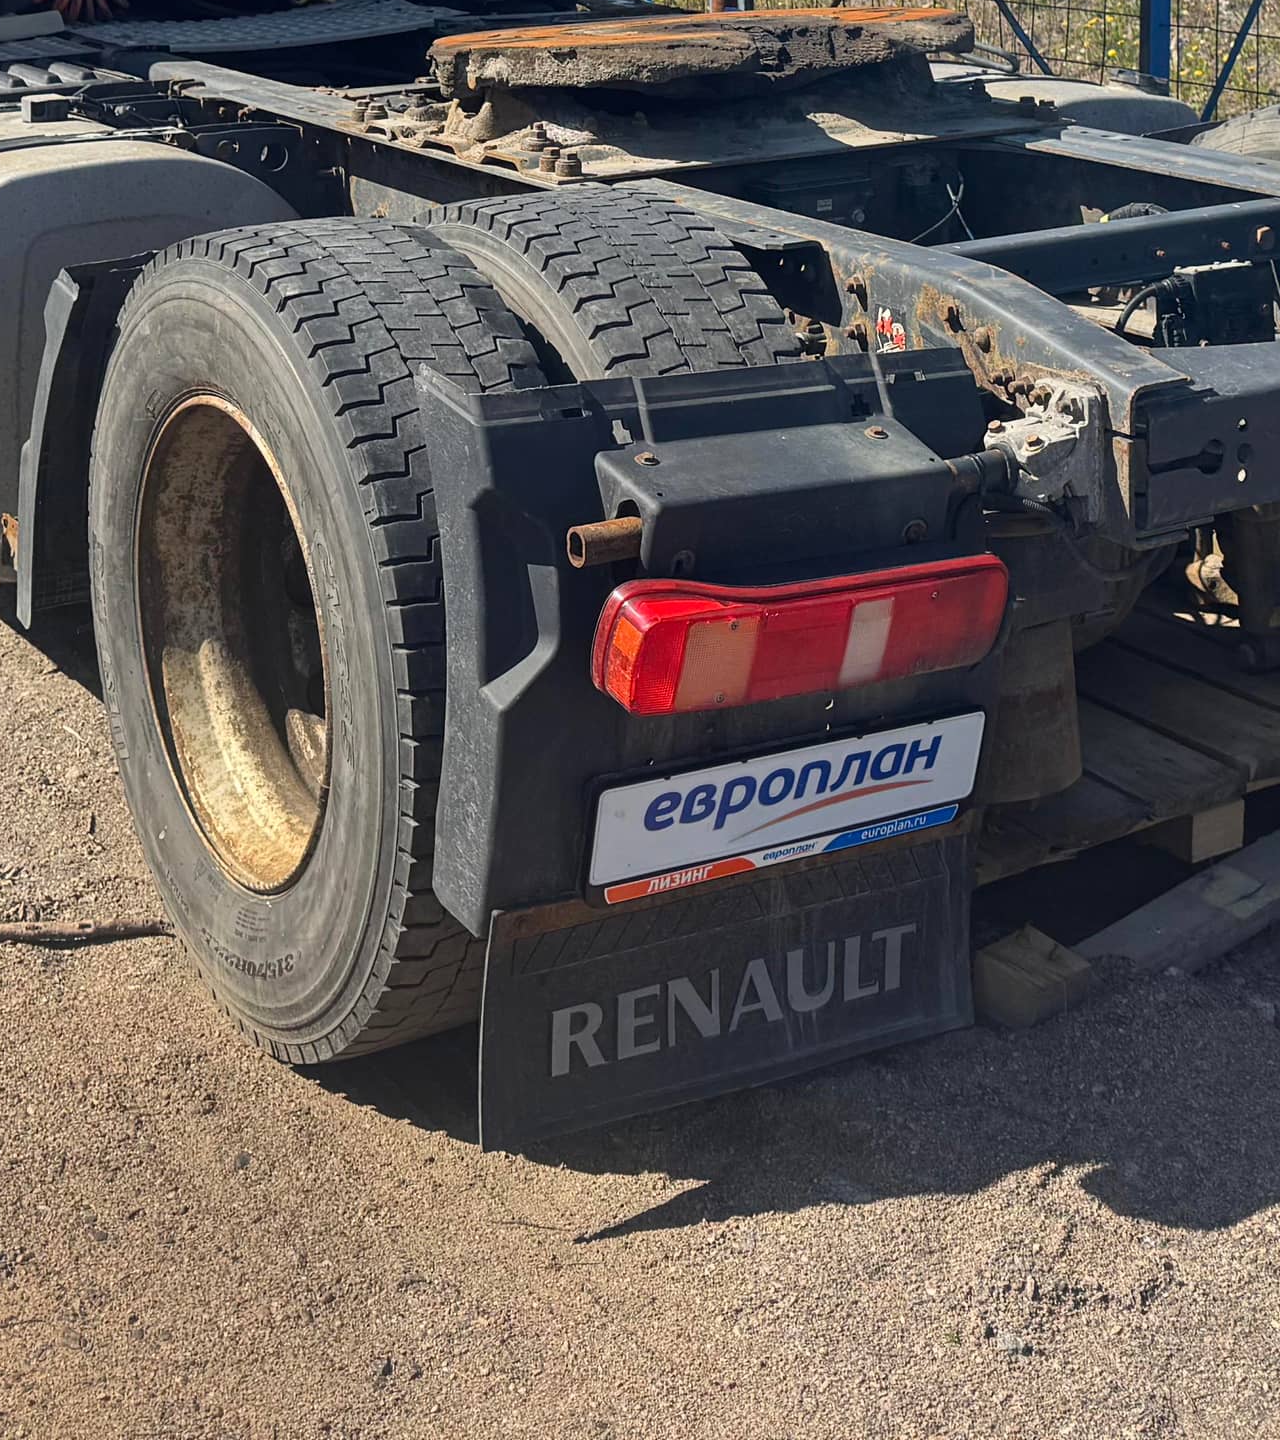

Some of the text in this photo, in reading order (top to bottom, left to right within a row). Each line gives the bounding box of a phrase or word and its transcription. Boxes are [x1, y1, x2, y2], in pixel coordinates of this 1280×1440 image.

[643, 735, 943, 832] европлан
[860, 814, 927, 840] europlan.ru
[762, 842, 816, 861] европлан
[647, 865, 713, 893] ЛИЗИНГ
[550, 922, 917, 1078] RENAULT
